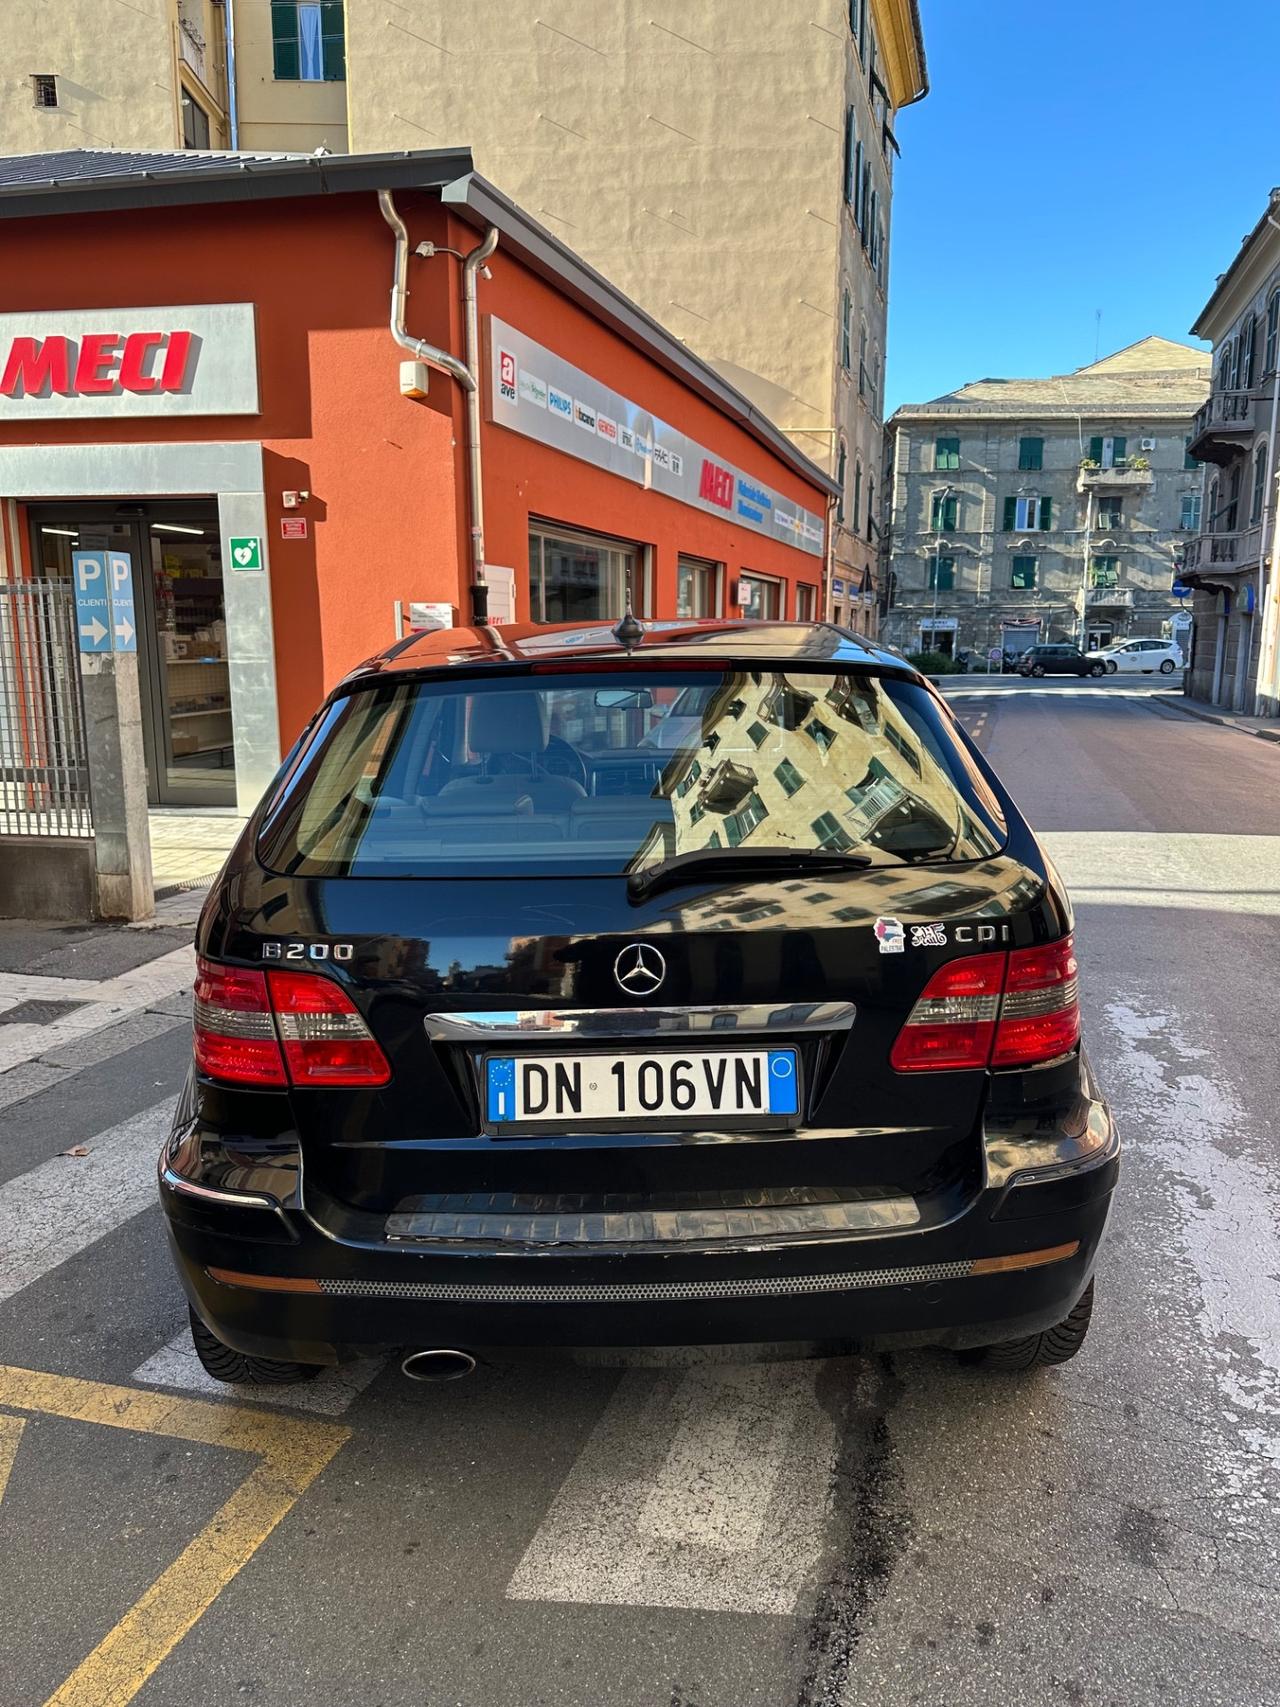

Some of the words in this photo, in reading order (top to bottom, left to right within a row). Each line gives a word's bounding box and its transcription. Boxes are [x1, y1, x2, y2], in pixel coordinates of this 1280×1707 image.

[1, 331, 192, 394] MECI
[500, 384, 516, 400] ave
[549, 392, 571, 415] PHILIPS
[78, 559, 101, 591] P
[112, 560, 129, 591] P
[78, 599, 108, 607] CLIENTI
[955, 925, 1009, 942] CDI
[522, 1061, 582, 1115] DN
[611, 1057, 762, 1112] 106VN
